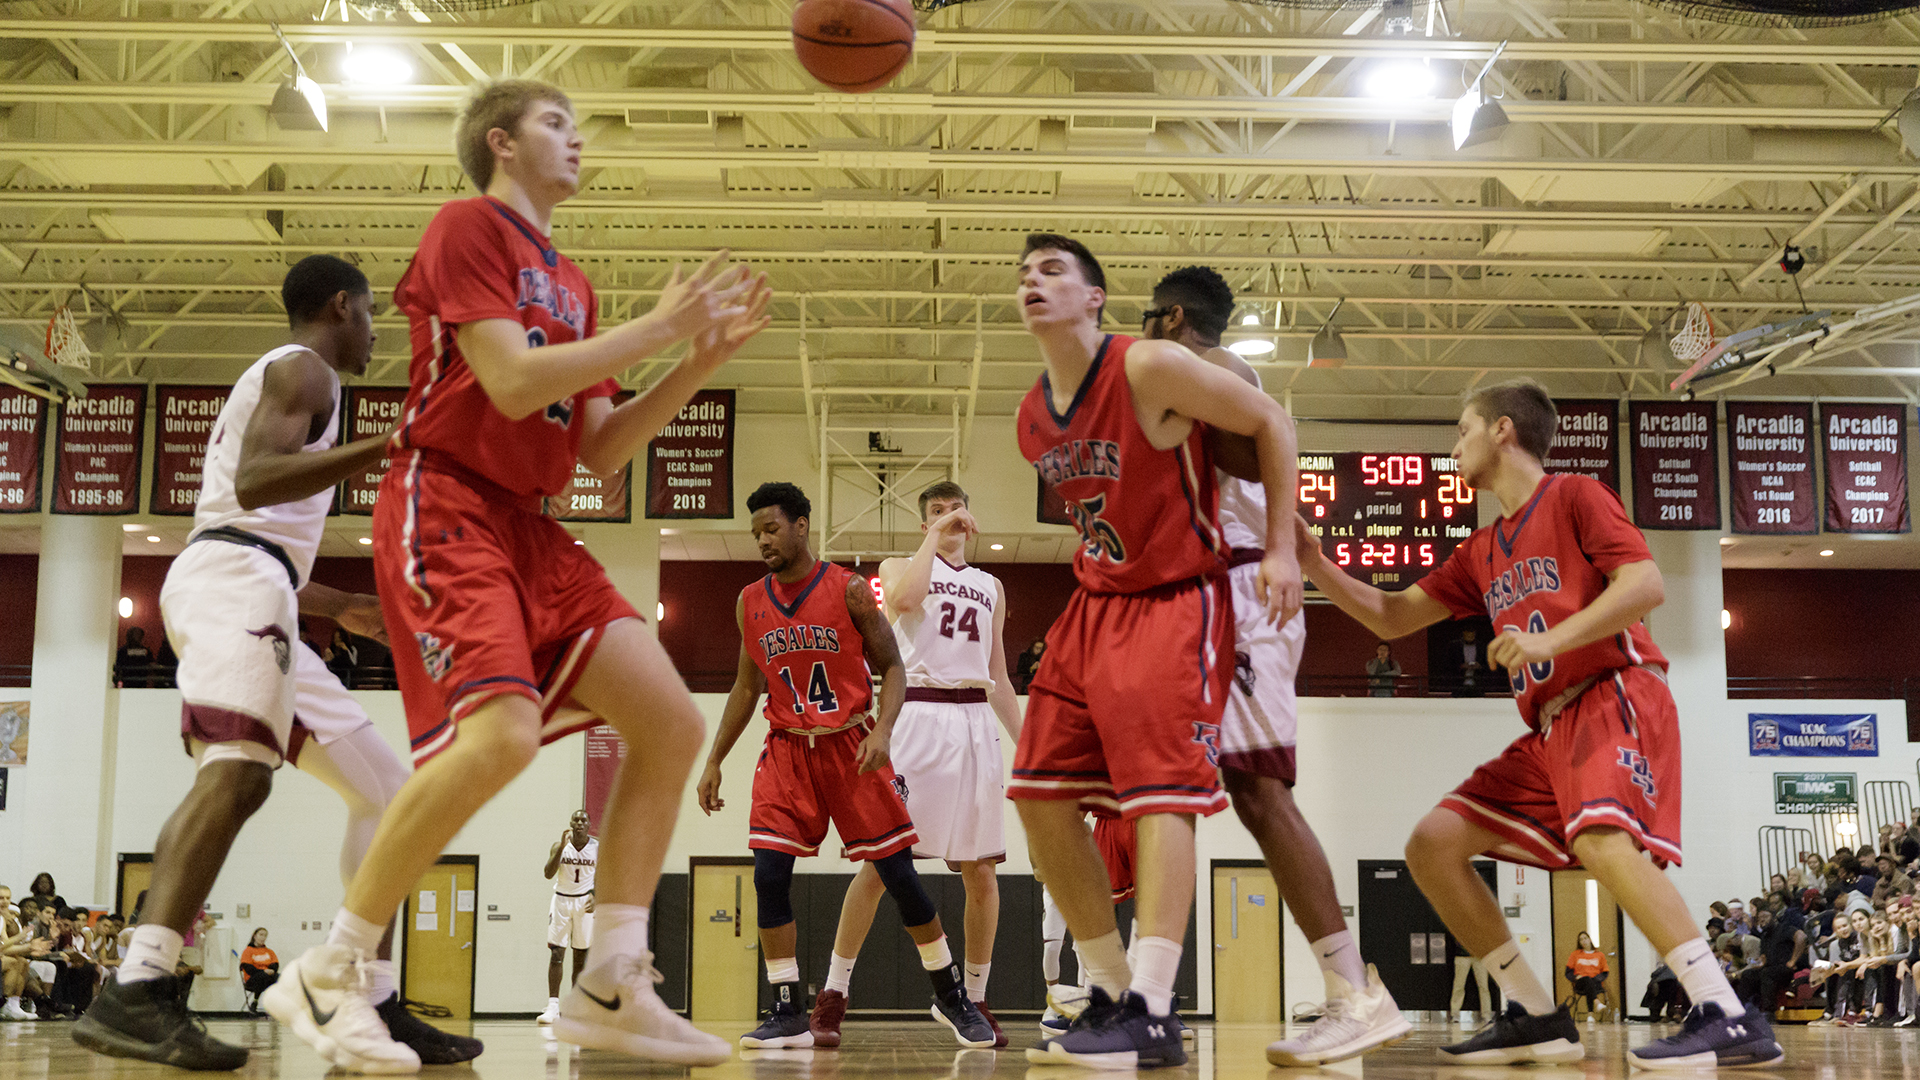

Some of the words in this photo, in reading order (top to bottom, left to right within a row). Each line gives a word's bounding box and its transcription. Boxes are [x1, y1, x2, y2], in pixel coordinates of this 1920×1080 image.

[0, 395, 37, 415] adia
[66, 396, 135, 415] Arcadia
[166, 396, 225, 416] Arcadi
[358, 398, 404, 418] Arca
[678, 401, 725, 421] cadia
[65, 416, 134, 434] University
[165, 417, 216, 433] Univers
[357, 419, 393, 434] Unive
[1557, 412, 1609, 431] cadia
[1640, 411, 1707, 431] Arcadia
[1736, 414, 1804, 434] Arcadia
[1829, 414, 1898, 435] Arcadia
[65, 442, 97, 453] Women's
[98, 442, 133, 453] Lacrosse
[164, 443, 196, 453] Women's
[1551, 433, 1609, 450] niversity
[1640, 433, 1708, 450] University
[1737, 436, 1805, 453] University
[1829, 436, 1897, 454] University
[656, 447, 692, 458] Women's
[695, 447, 724, 458] Soccer
[90, 457, 106, 468] PAC
[667, 462, 687, 472] ECAC
[690, 462, 713, 472] South
[1580, 457, 1609, 468] Soccer
[1659, 458, 1691, 469] Softball
[1738, 461, 1774, 471] Women's
[1776, 461, 1806, 472] Soccer
[1849, 461, 1882, 472] Softball
[75, 471, 119, 483] Champions
[174, 471, 203, 484] Champ
[1361, 455, 1423, 486] 5:09
[1431, 457, 1459, 471] VISIT
[1652, 473, 1672, 483] ECAC
[1675, 473, 1699, 483] South
[574, 477, 602, 488] NCAA's
[668, 476, 712, 488] Champions
[1300, 473, 1336, 503] 24
[1761, 475, 1784, 486] NCAA
[1855, 476, 1877, 486] ECAC
[1437, 474, 1474, 504] 20
[1654, 487, 1698, 499] Champions
[1753, 490, 1767, 501] 1st
[1769, 490, 1794, 501] Round
[1845, 490, 1889, 502] Champions
[70, 489, 124, 505] 1995-96
[169, 489, 200, 505] 1996
[571, 494, 603, 510] 2005
[673, 494, 706, 509] 2013
[1366, 502, 1402, 518] period
[1420, 498, 1427, 518] 1
[1660, 504, 1693, 520] 2016
[1757, 508, 1791, 523] 2016
[1851, 508, 1884, 523] 2017
[1366, 523, 1403, 538] player
[1445, 525, 1471, 538] fouls
[1337, 543, 1350, 566] 5
[1420, 543, 1434, 566] 5
[1372, 573, 1400, 585] game
[938, 601, 981, 643] 24
[778, 660, 840, 714] 14
[1755, 725, 1776, 739] 75
[1800, 723, 1827, 734] ECAC
[1850, 726, 1871, 740] 75
[1782, 735, 1847, 747] CHAMPIONS
[1803, 773, 1826, 781] 2017
[560, 857, 595, 867] ARCADIA
[574, 869, 580, 883] 1
